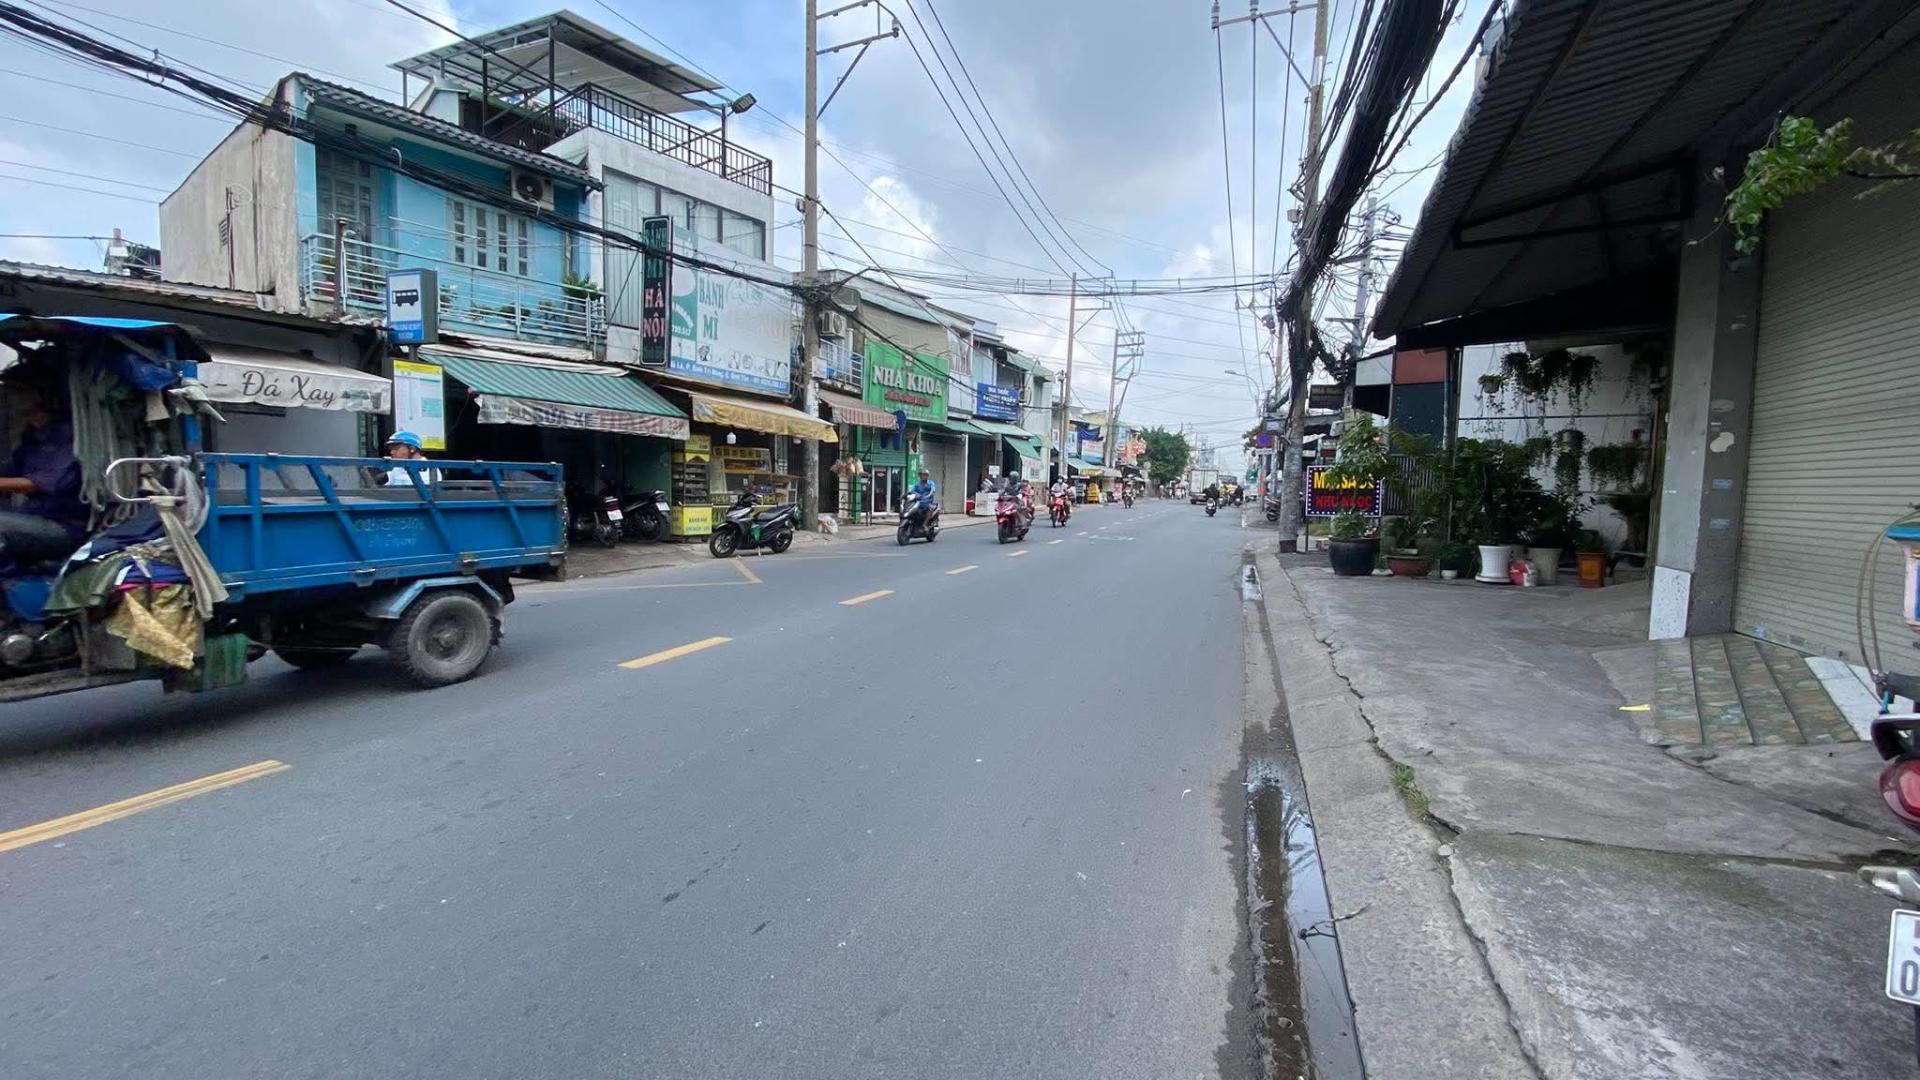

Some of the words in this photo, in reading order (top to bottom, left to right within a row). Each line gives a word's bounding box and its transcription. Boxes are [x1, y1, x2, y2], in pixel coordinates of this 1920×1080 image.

[643, 312, 665, 343] NỘI
[703, 310, 719, 341] MÌ
[242, 370, 282, 397] Đá
[290, 375, 338, 407] Xay
[873, 365, 903, 389] NHA
[907, 372, 943, 397] KHOA
